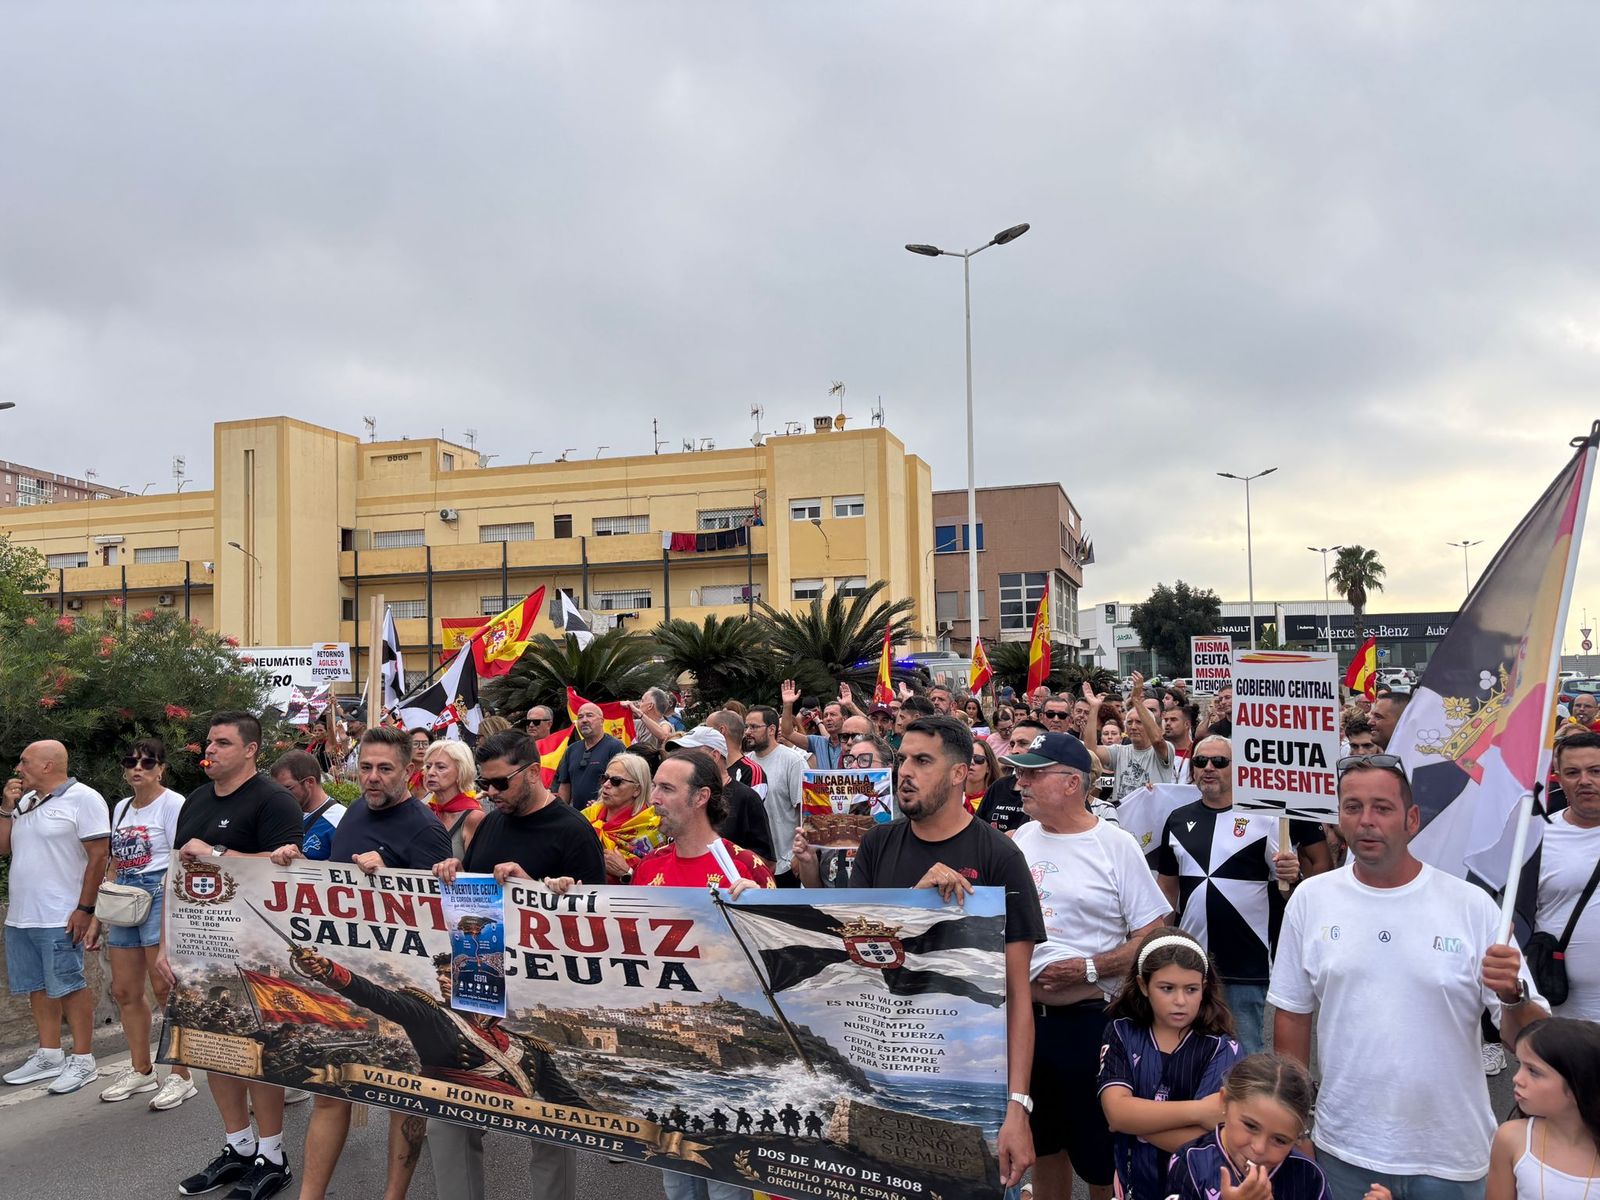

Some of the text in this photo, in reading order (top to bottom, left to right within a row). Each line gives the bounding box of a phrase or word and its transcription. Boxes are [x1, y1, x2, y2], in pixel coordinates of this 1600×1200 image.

[1317, 625, 1409, 639] Mercees-Benz
[1194, 642, 1230, 652] MISMA
[1194, 654, 1232, 666] CEUTA,
[1195, 668, 1231, 679] MISMA
[1236, 678, 1335, 700] GOBIERNO CENTRAL
[1236, 702, 1335, 732] AUSENTE
[1244, 738, 1327, 768] CEUTA
[836, 786, 846, 795] SE
[1237, 766, 1336, 796] PRESENTE
[328, 868, 442, 895] EL TENIE
[451, 883, 472, 895] PUERTO
[472, 884, 480, 895] DE
[480, 884, 499, 896] CEUTA
[263, 880, 448, 932] JACINT
[511, 886, 598, 914] CEUTÍ
[179, 907, 204, 915] HÉROE
[217, 915, 242, 923] MAYO
[209, 934, 234, 942] PATRIA
[290, 916, 430, 958] SALVA
[518, 908, 701, 959] RUIZ
[176, 943, 200, 951] HASTA
[473, 974, 487, 983] CEUTA
[846, 1000, 892, 1015] NUESTRO
[896, 1007, 959, 1017] ORGULLO
[860, 992, 913, 1007] SU VALOR
[844, 1021, 945, 1041] NUESTRA FUERZA
[857, 1014, 926, 1031] SU EJEMPLO
[844, 1034, 946, 1056] CEUTA, ESPAÑOLA
[850, 1044, 938, 1065] DESDE SIEMPRE
[849, 1051, 941, 1074] Y PARA SIEMPRE
[363, 1069, 641, 1134] VALOR HONOR LEALTAD
[365, 1090, 624, 1153] CEUTA, INQUEBRANTABLE
[880, 1115, 953, 1140] CEUTA
[881, 1142, 969, 1171] SIEMPRE
[757, 1147, 922, 1193] DOS DE MAYO DE 1808
[768, 1165, 820, 1184] EJEMPLO
[824, 1177, 856, 1192] PARA
[767, 1175, 822, 1195] ORGULLO
